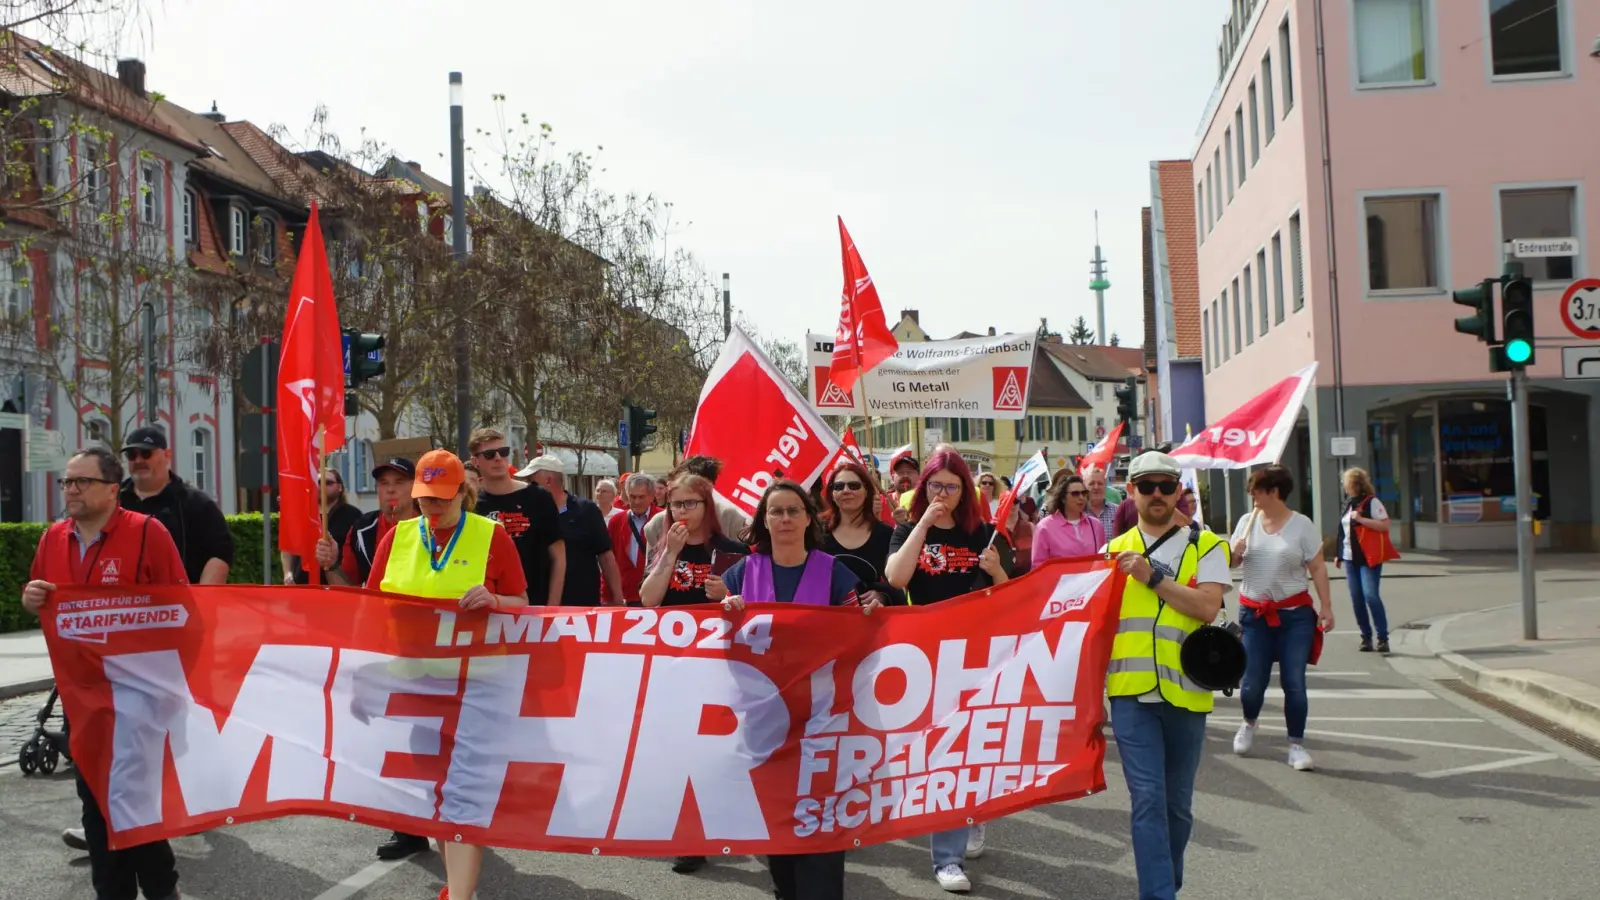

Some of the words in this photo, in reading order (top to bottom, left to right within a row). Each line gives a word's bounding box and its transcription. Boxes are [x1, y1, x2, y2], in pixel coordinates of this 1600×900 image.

[1518, 242, 1573, 253] Endresstraße
[906, 340, 1032, 360] Wolframs-Eschenbach
[877, 367, 927, 377] gemeinsam
[945, 367, 960, 376] der
[892, 381, 907, 393] IG
[909, 381, 950, 393] Metall
[868, 398, 979, 410] Westmittelfranken
[57, 597, 111, 612] EINTRETEN
[111, 594, 132, 605] FÜR
[134, 594, 152, 604] DIE
[59, 608, 180, 630] #TARIFWENDE
[434, 609, 474, 646] 1.
[484, 610, 614, 645] MAI
[621, 610, 774, 655] 2024
[804, 621, 1091, 737] LOHN
[102, 643, 790, 841] MEHR
[796, 705, 1076, 796] FREIZEIT
[793, 763, 1070, 838] SICHERHEIT
